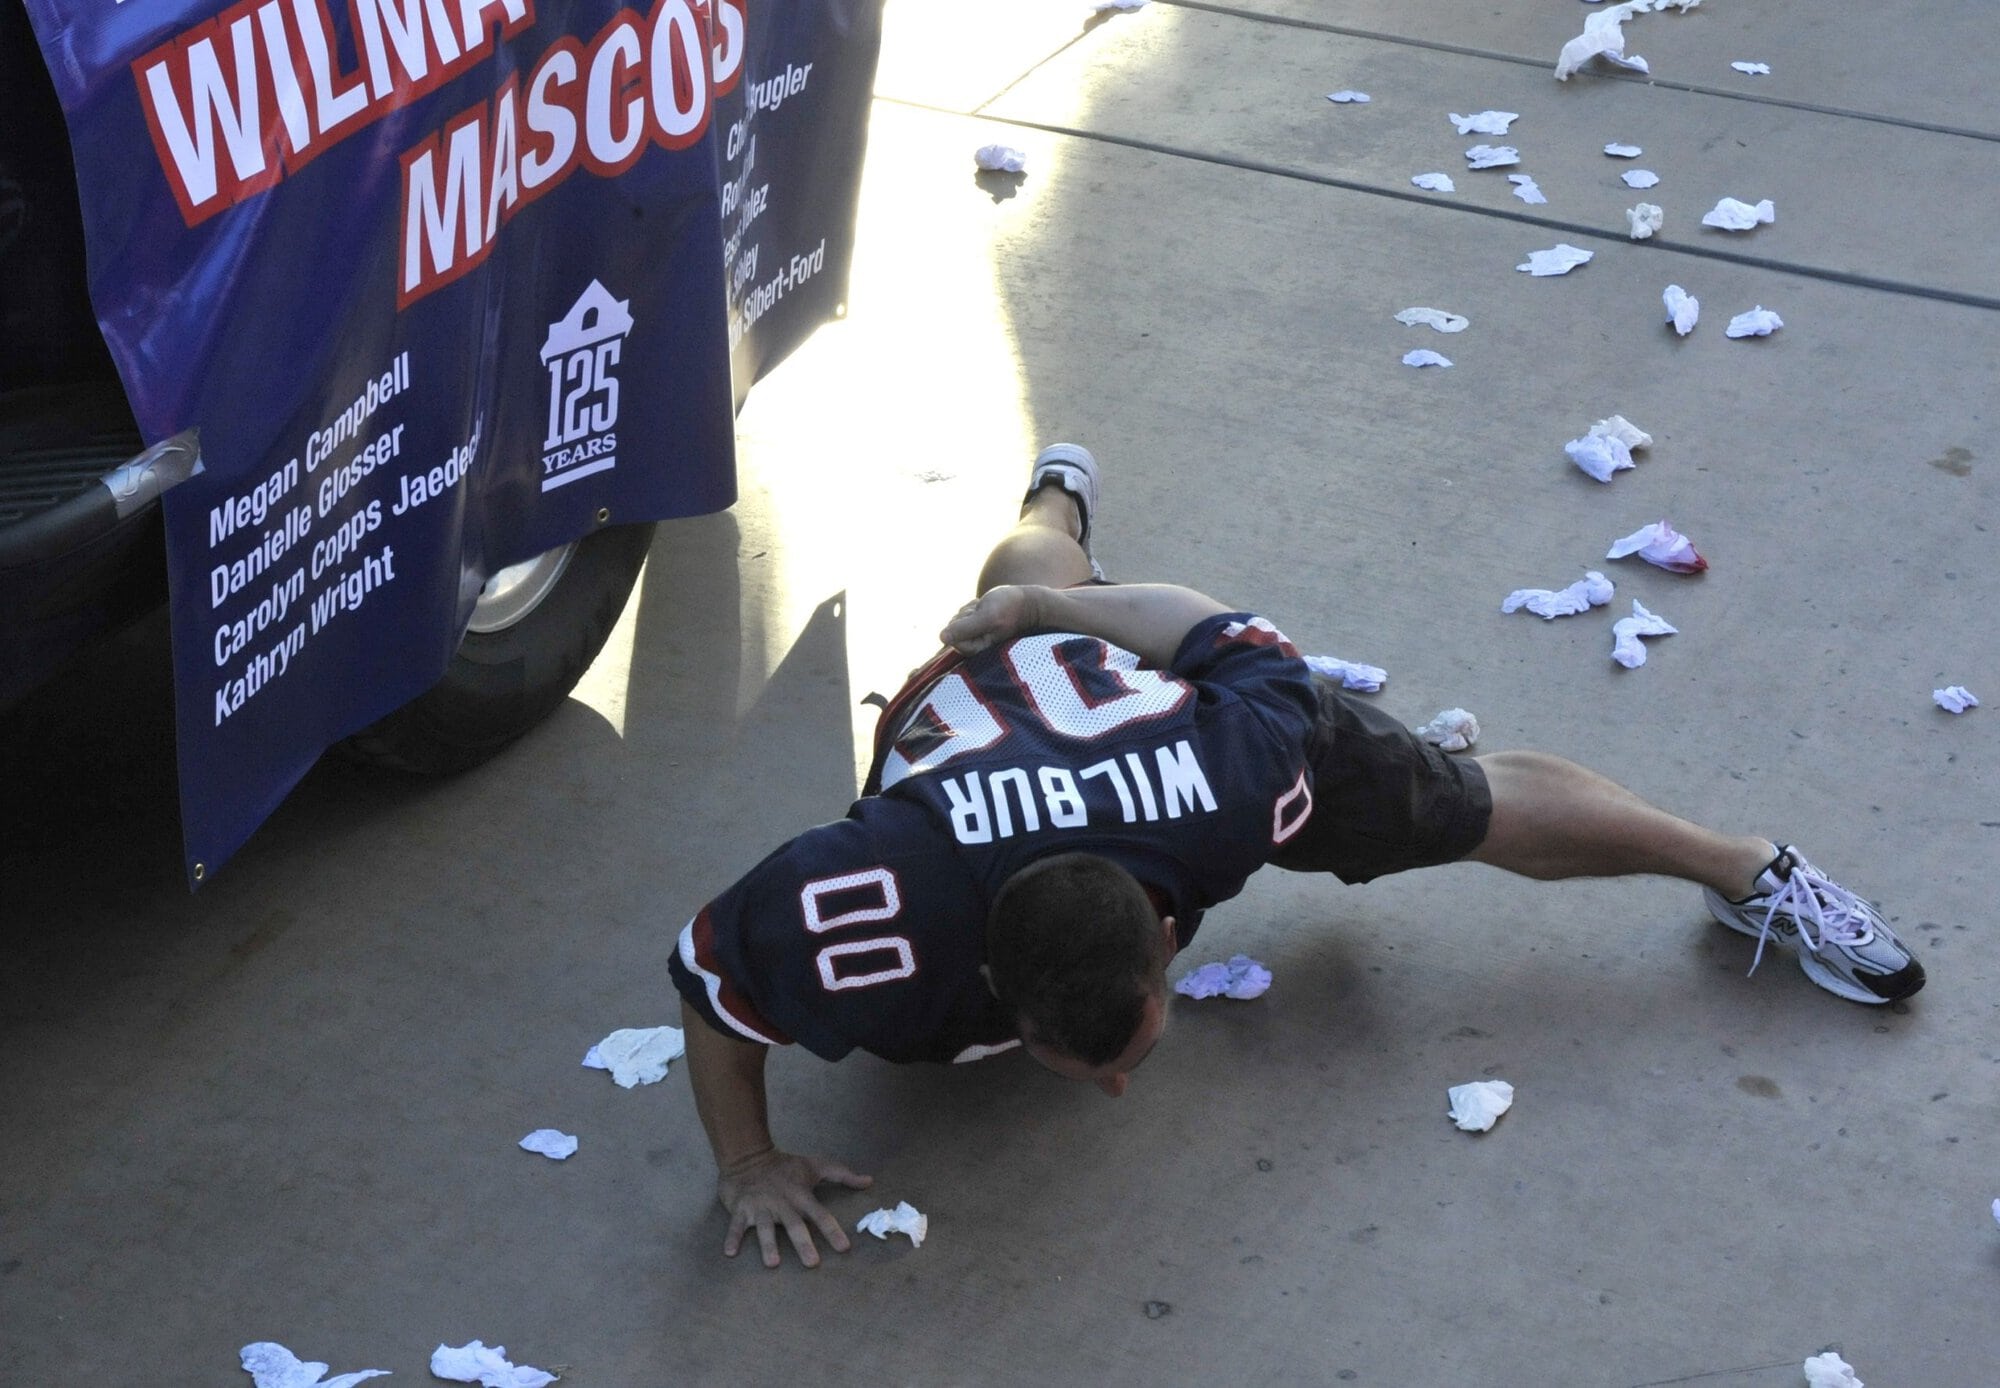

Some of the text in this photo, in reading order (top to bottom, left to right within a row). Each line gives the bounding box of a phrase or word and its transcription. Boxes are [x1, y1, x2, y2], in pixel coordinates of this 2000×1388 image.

[405, 0, 744, 293] MASCOS
[750, 62, 814, 121] rugler
[743, 237, 826, 334] Silbert-Ford
[209, 350, 410, 548] Megan Campbell
[541, 432, 617, 474] YEARS
[543, 338, 622, 452] 125
[210, 423, 405, 609] Danielle Glosser
[213, 563, 305, 667] Carolyn
[311, 498, 382, 580] Copps
[214, 545, 395, 728] Kathryn Wright
[941, 740, 1218, 844] WILBUR
[801, 868, 916, 992] 00
